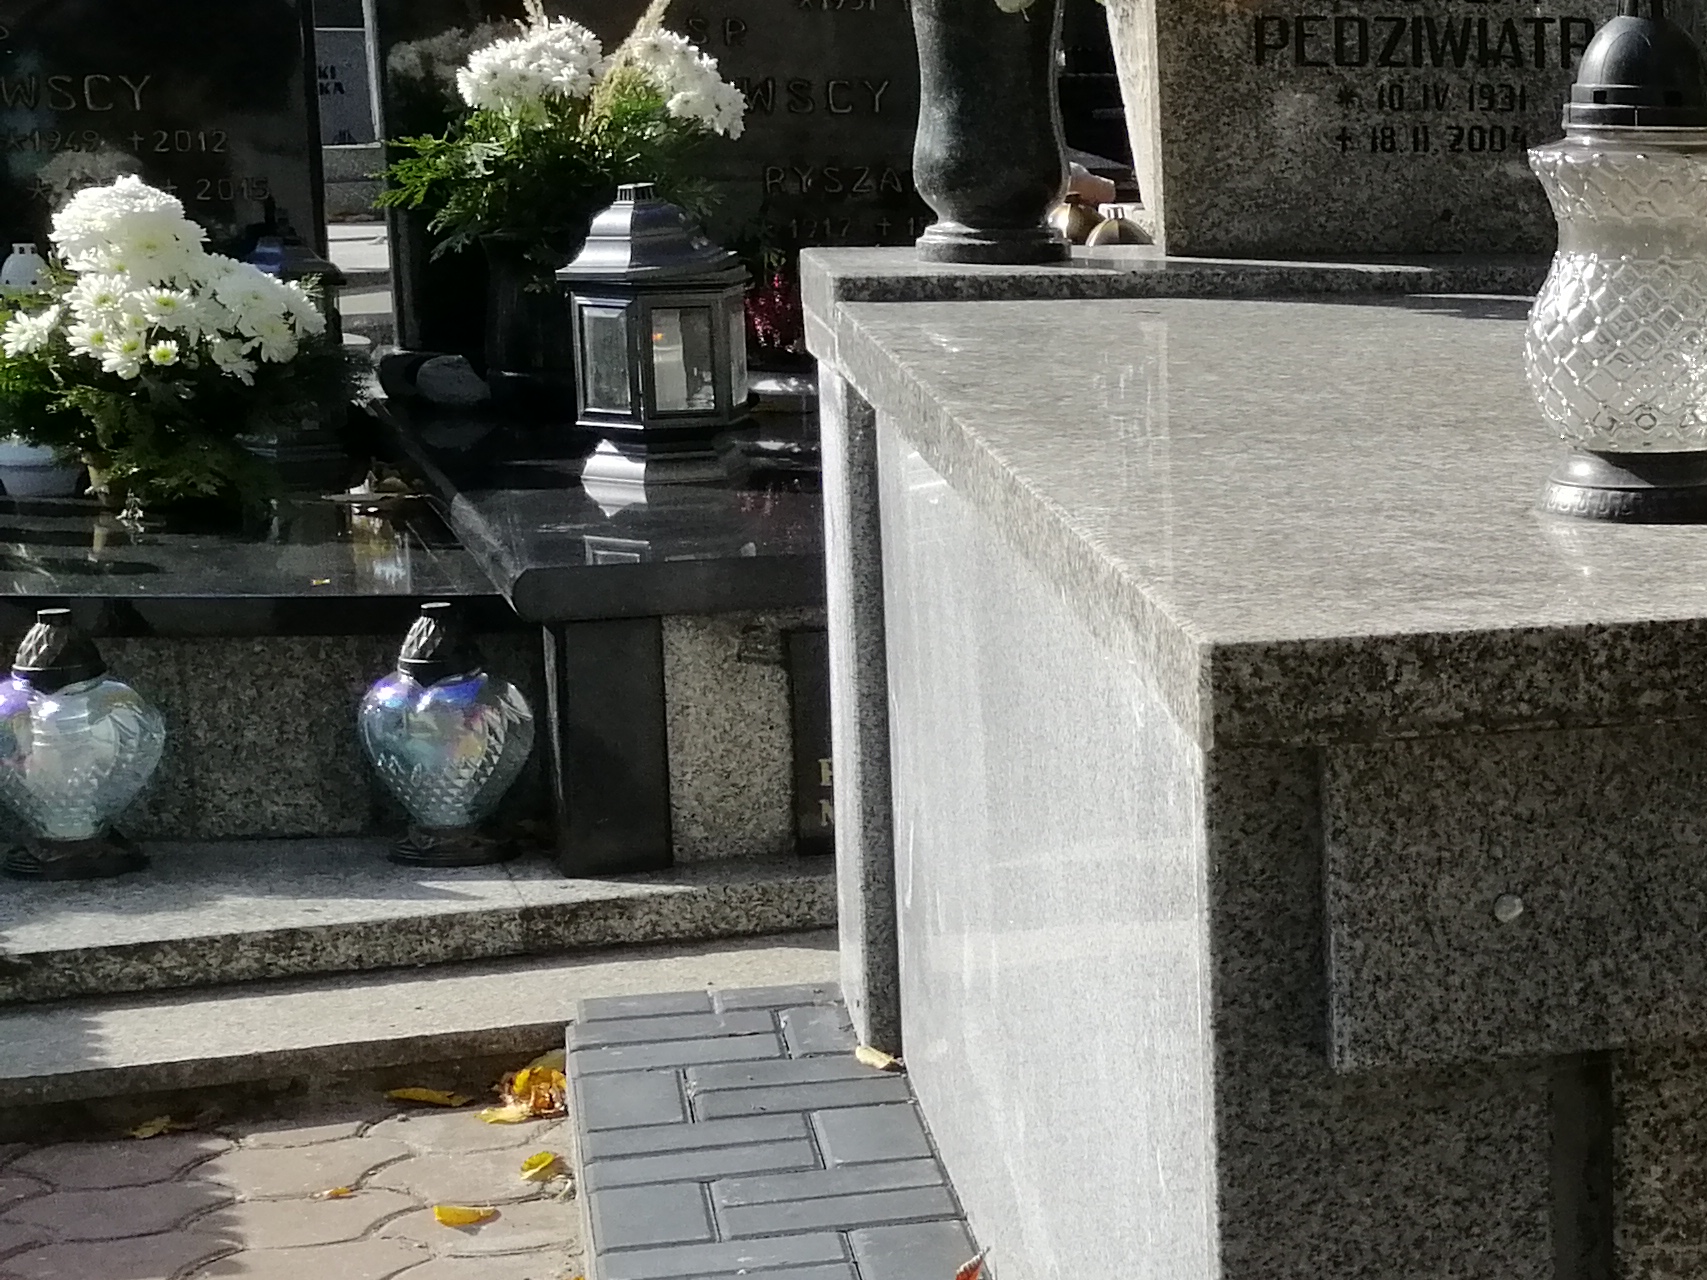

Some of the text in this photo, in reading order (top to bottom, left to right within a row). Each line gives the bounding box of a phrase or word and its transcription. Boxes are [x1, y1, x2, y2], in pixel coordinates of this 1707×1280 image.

[1468, 83, 1527, 112] 1931
[152, 130, 228, 153] 2012
[1446, 125, 1528, 154] 2004
[196, 178, 271, 201] 2015
[766, 166, 919, 194] RYSZA
